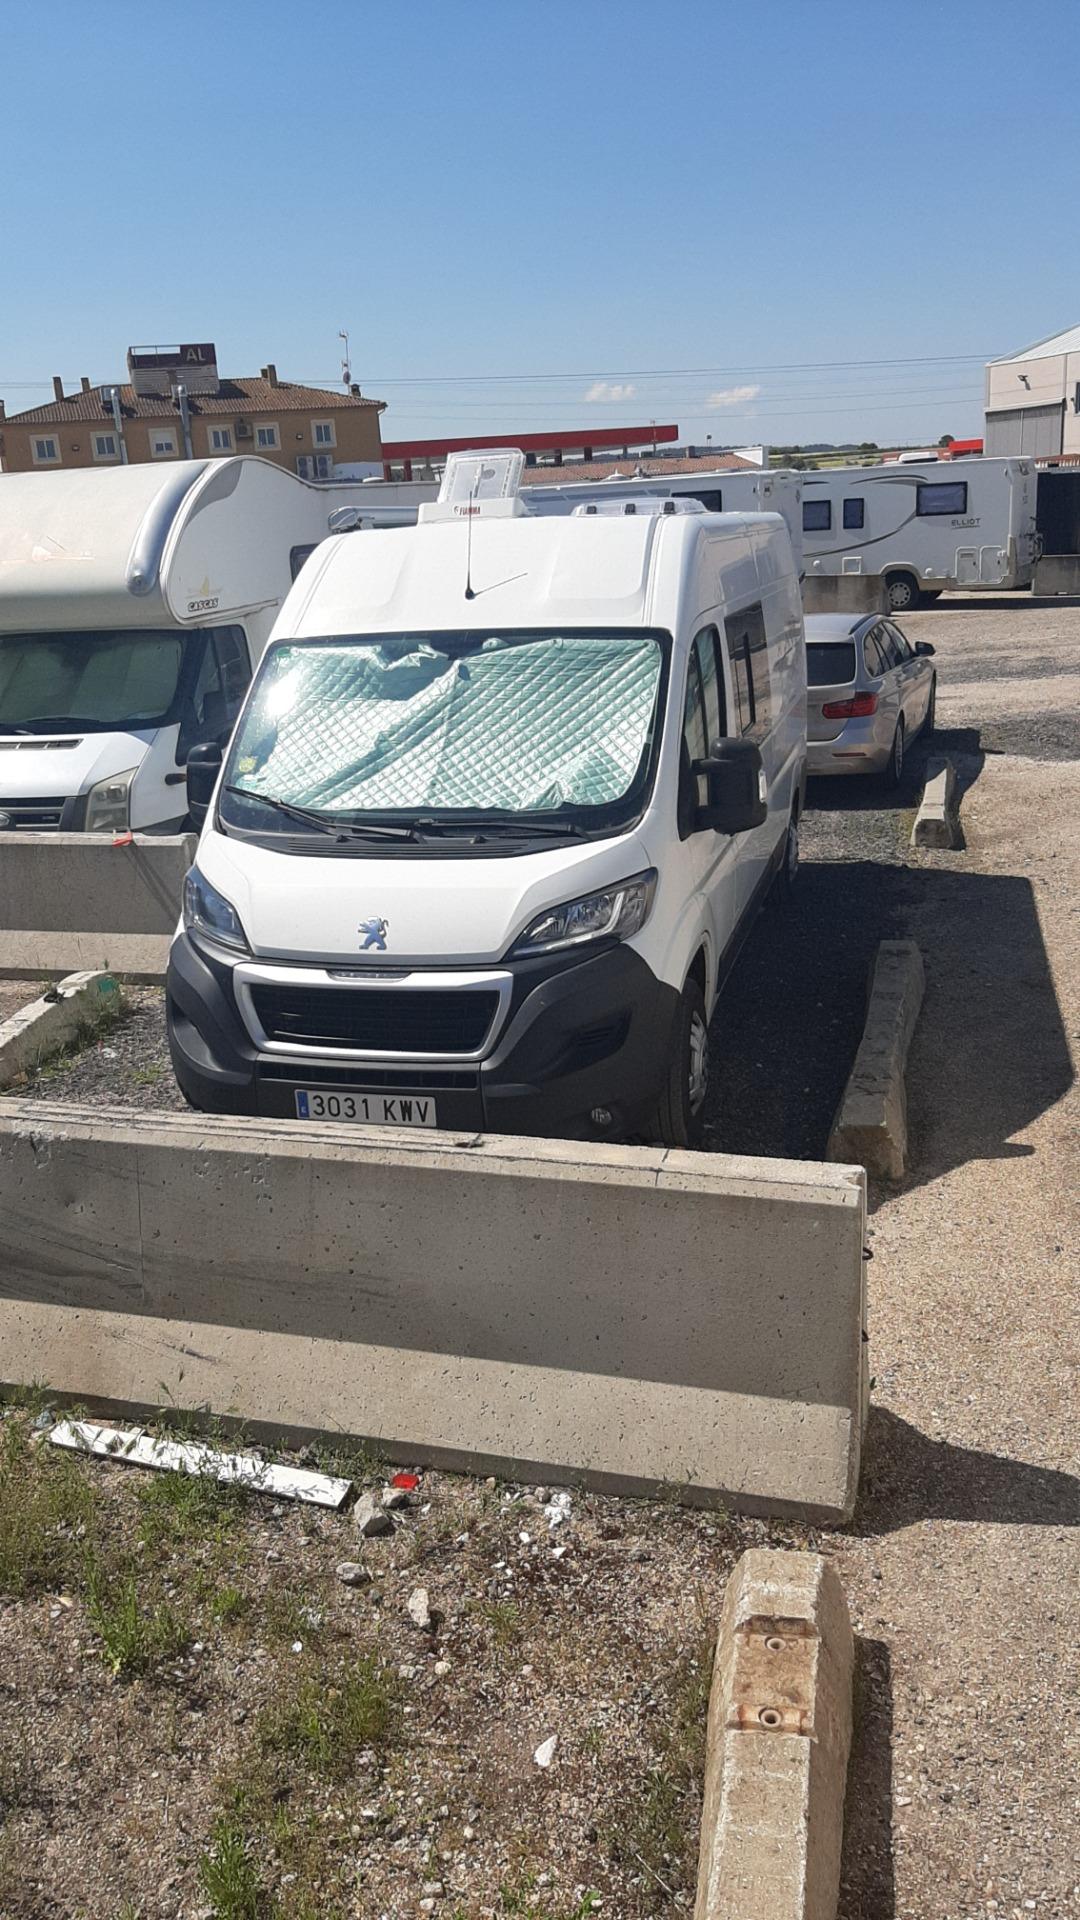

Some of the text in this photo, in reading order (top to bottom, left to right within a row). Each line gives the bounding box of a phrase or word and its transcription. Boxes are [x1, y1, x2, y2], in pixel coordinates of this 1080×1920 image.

[951, 518, 981, 527] ELLIOT
[312, 1094, 428, 1123] 3031 KWV
